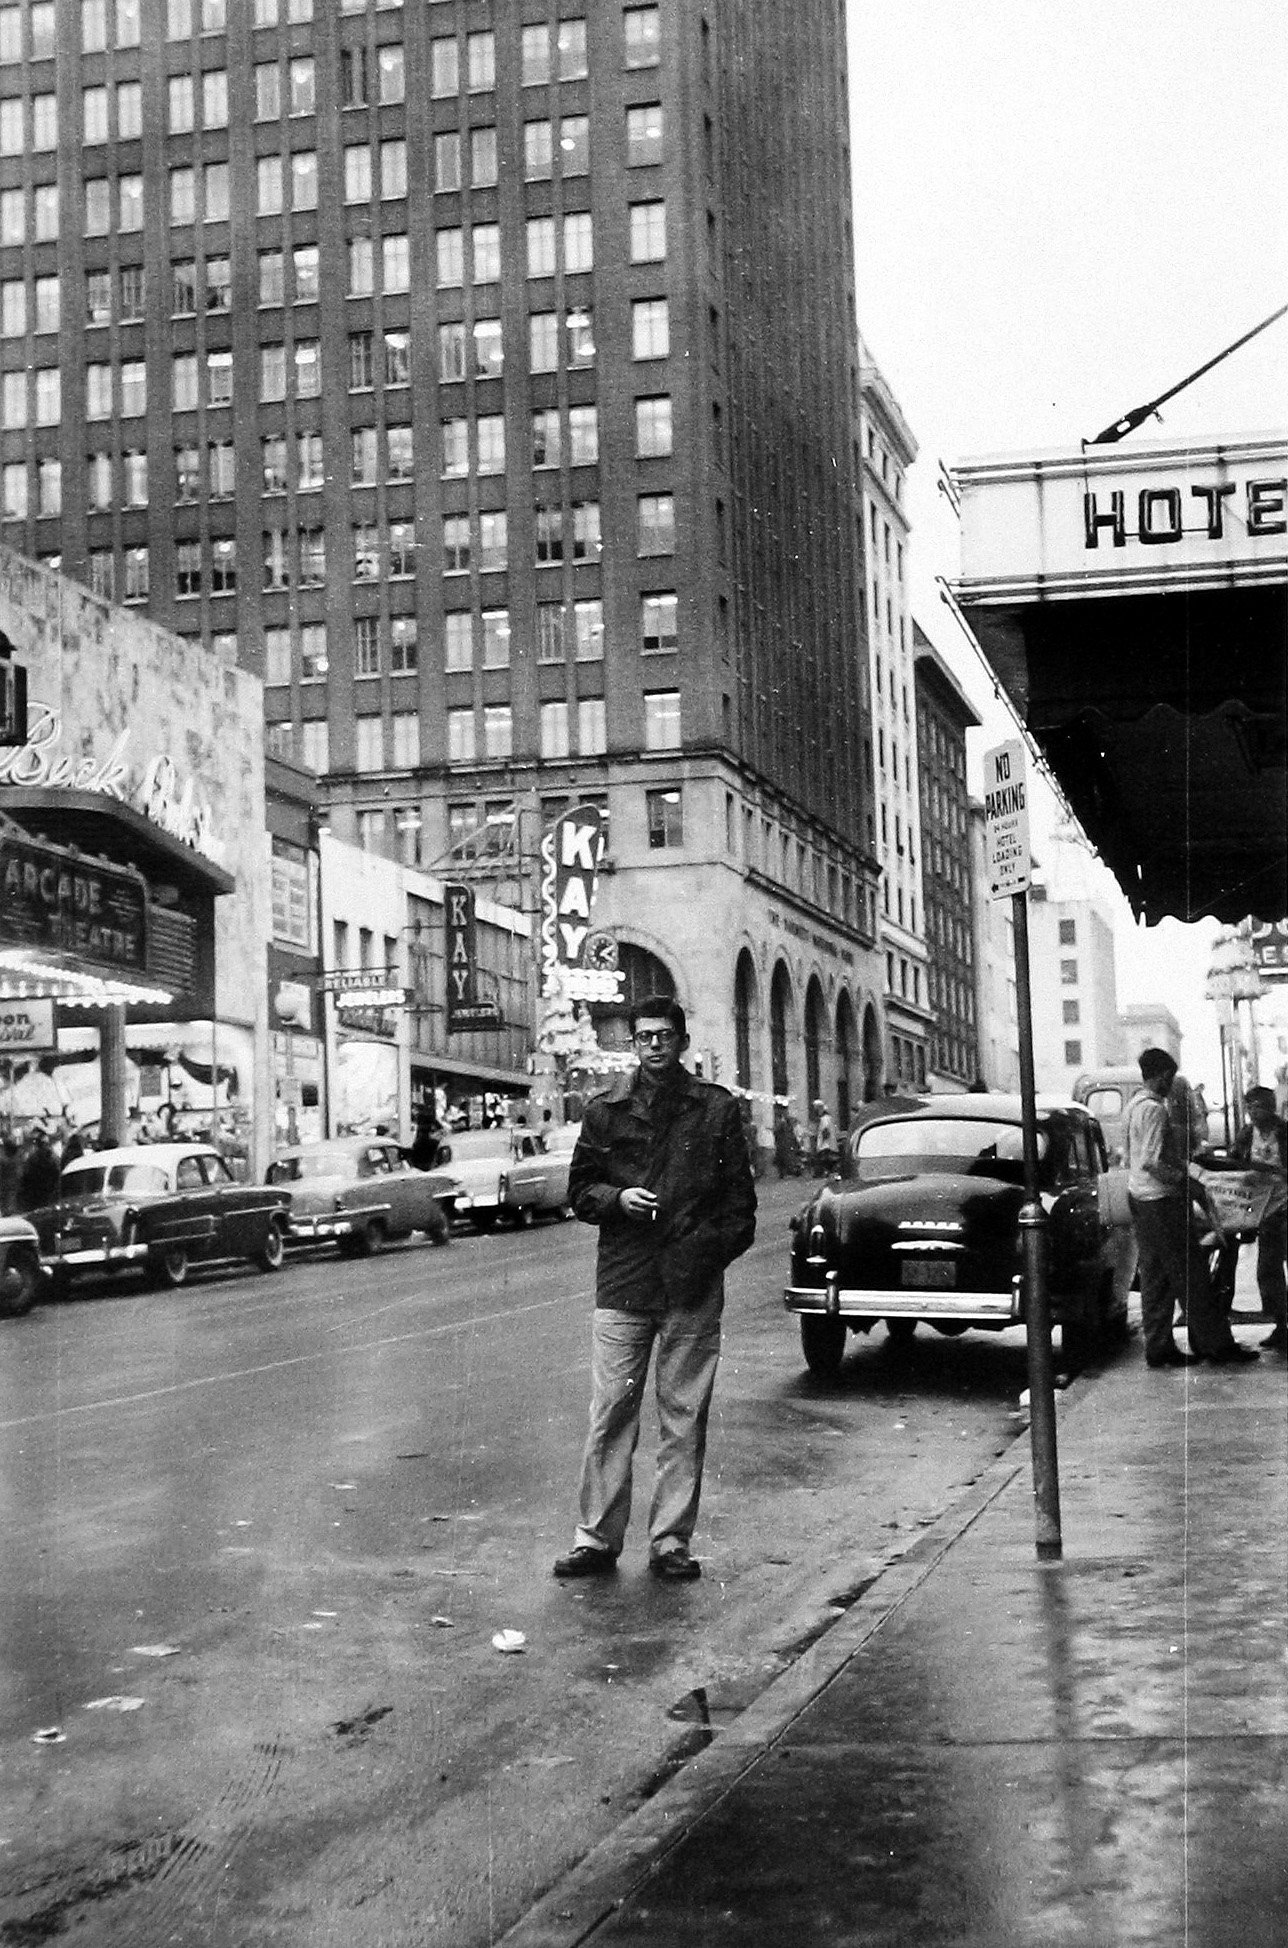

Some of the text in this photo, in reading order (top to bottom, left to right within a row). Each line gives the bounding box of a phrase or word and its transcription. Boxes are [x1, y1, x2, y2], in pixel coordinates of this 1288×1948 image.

[995, 752, 1011, 783] NO
[985, 782, 1025, 820] PARKING
[992, 845, 1023, 864] LOADING
[4, 859, 102, 915] ARCADE
[557, 821, 598, 959] KAY
[451, 894, 469, 999] KAY
[0, 1014, 30, 1025] on
